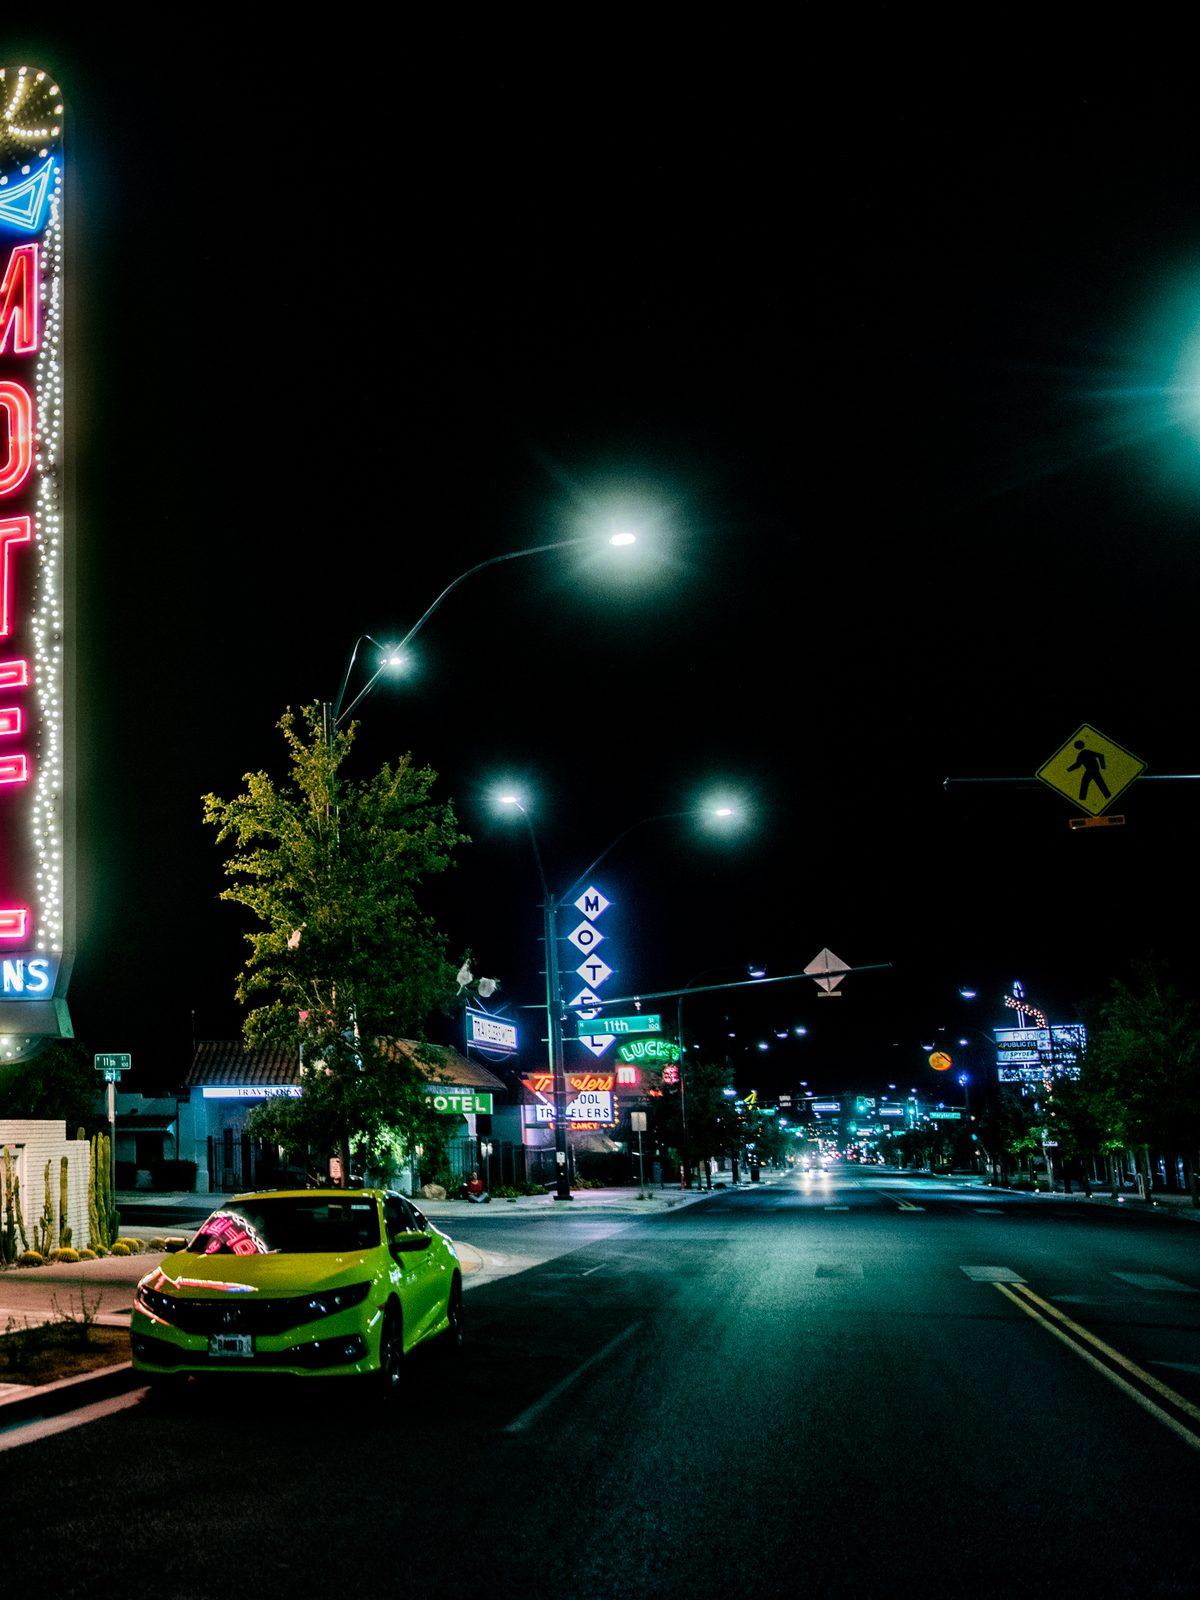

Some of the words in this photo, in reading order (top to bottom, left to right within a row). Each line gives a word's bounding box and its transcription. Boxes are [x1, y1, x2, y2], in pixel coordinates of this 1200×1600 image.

[577, 895, 604, 1047] MOTEL
[603, 1019, 629, 1032] 11th
[540, 1108, 610, 1118] TRELERS
